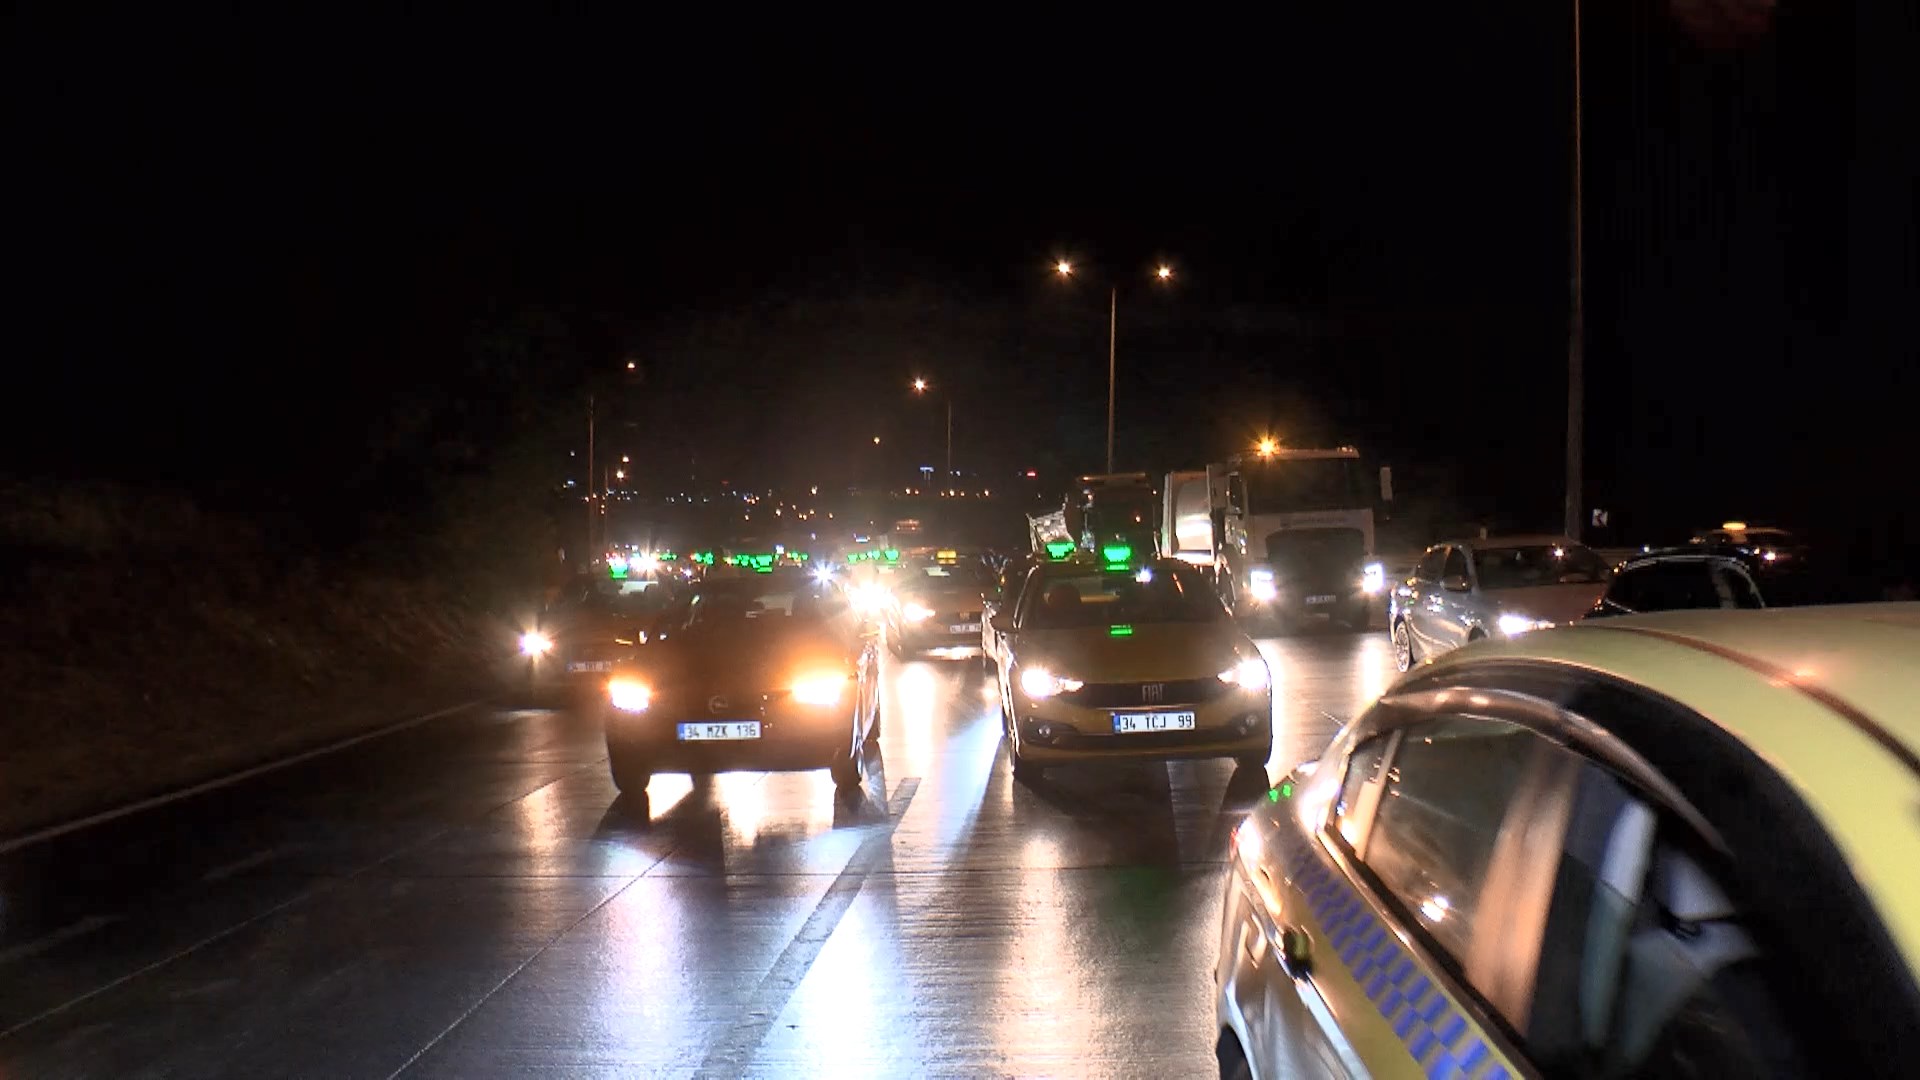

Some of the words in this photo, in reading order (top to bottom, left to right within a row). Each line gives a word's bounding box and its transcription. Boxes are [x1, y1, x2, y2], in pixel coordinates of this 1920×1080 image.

[1142, 683, 1165, 701] FIAT
[1122, 716, 1136, 730] 34
[1145, 714, 1166, 729] TCJ
[1178, 714, 1192, 728] 99
[687, 725, 699, 738] 34
